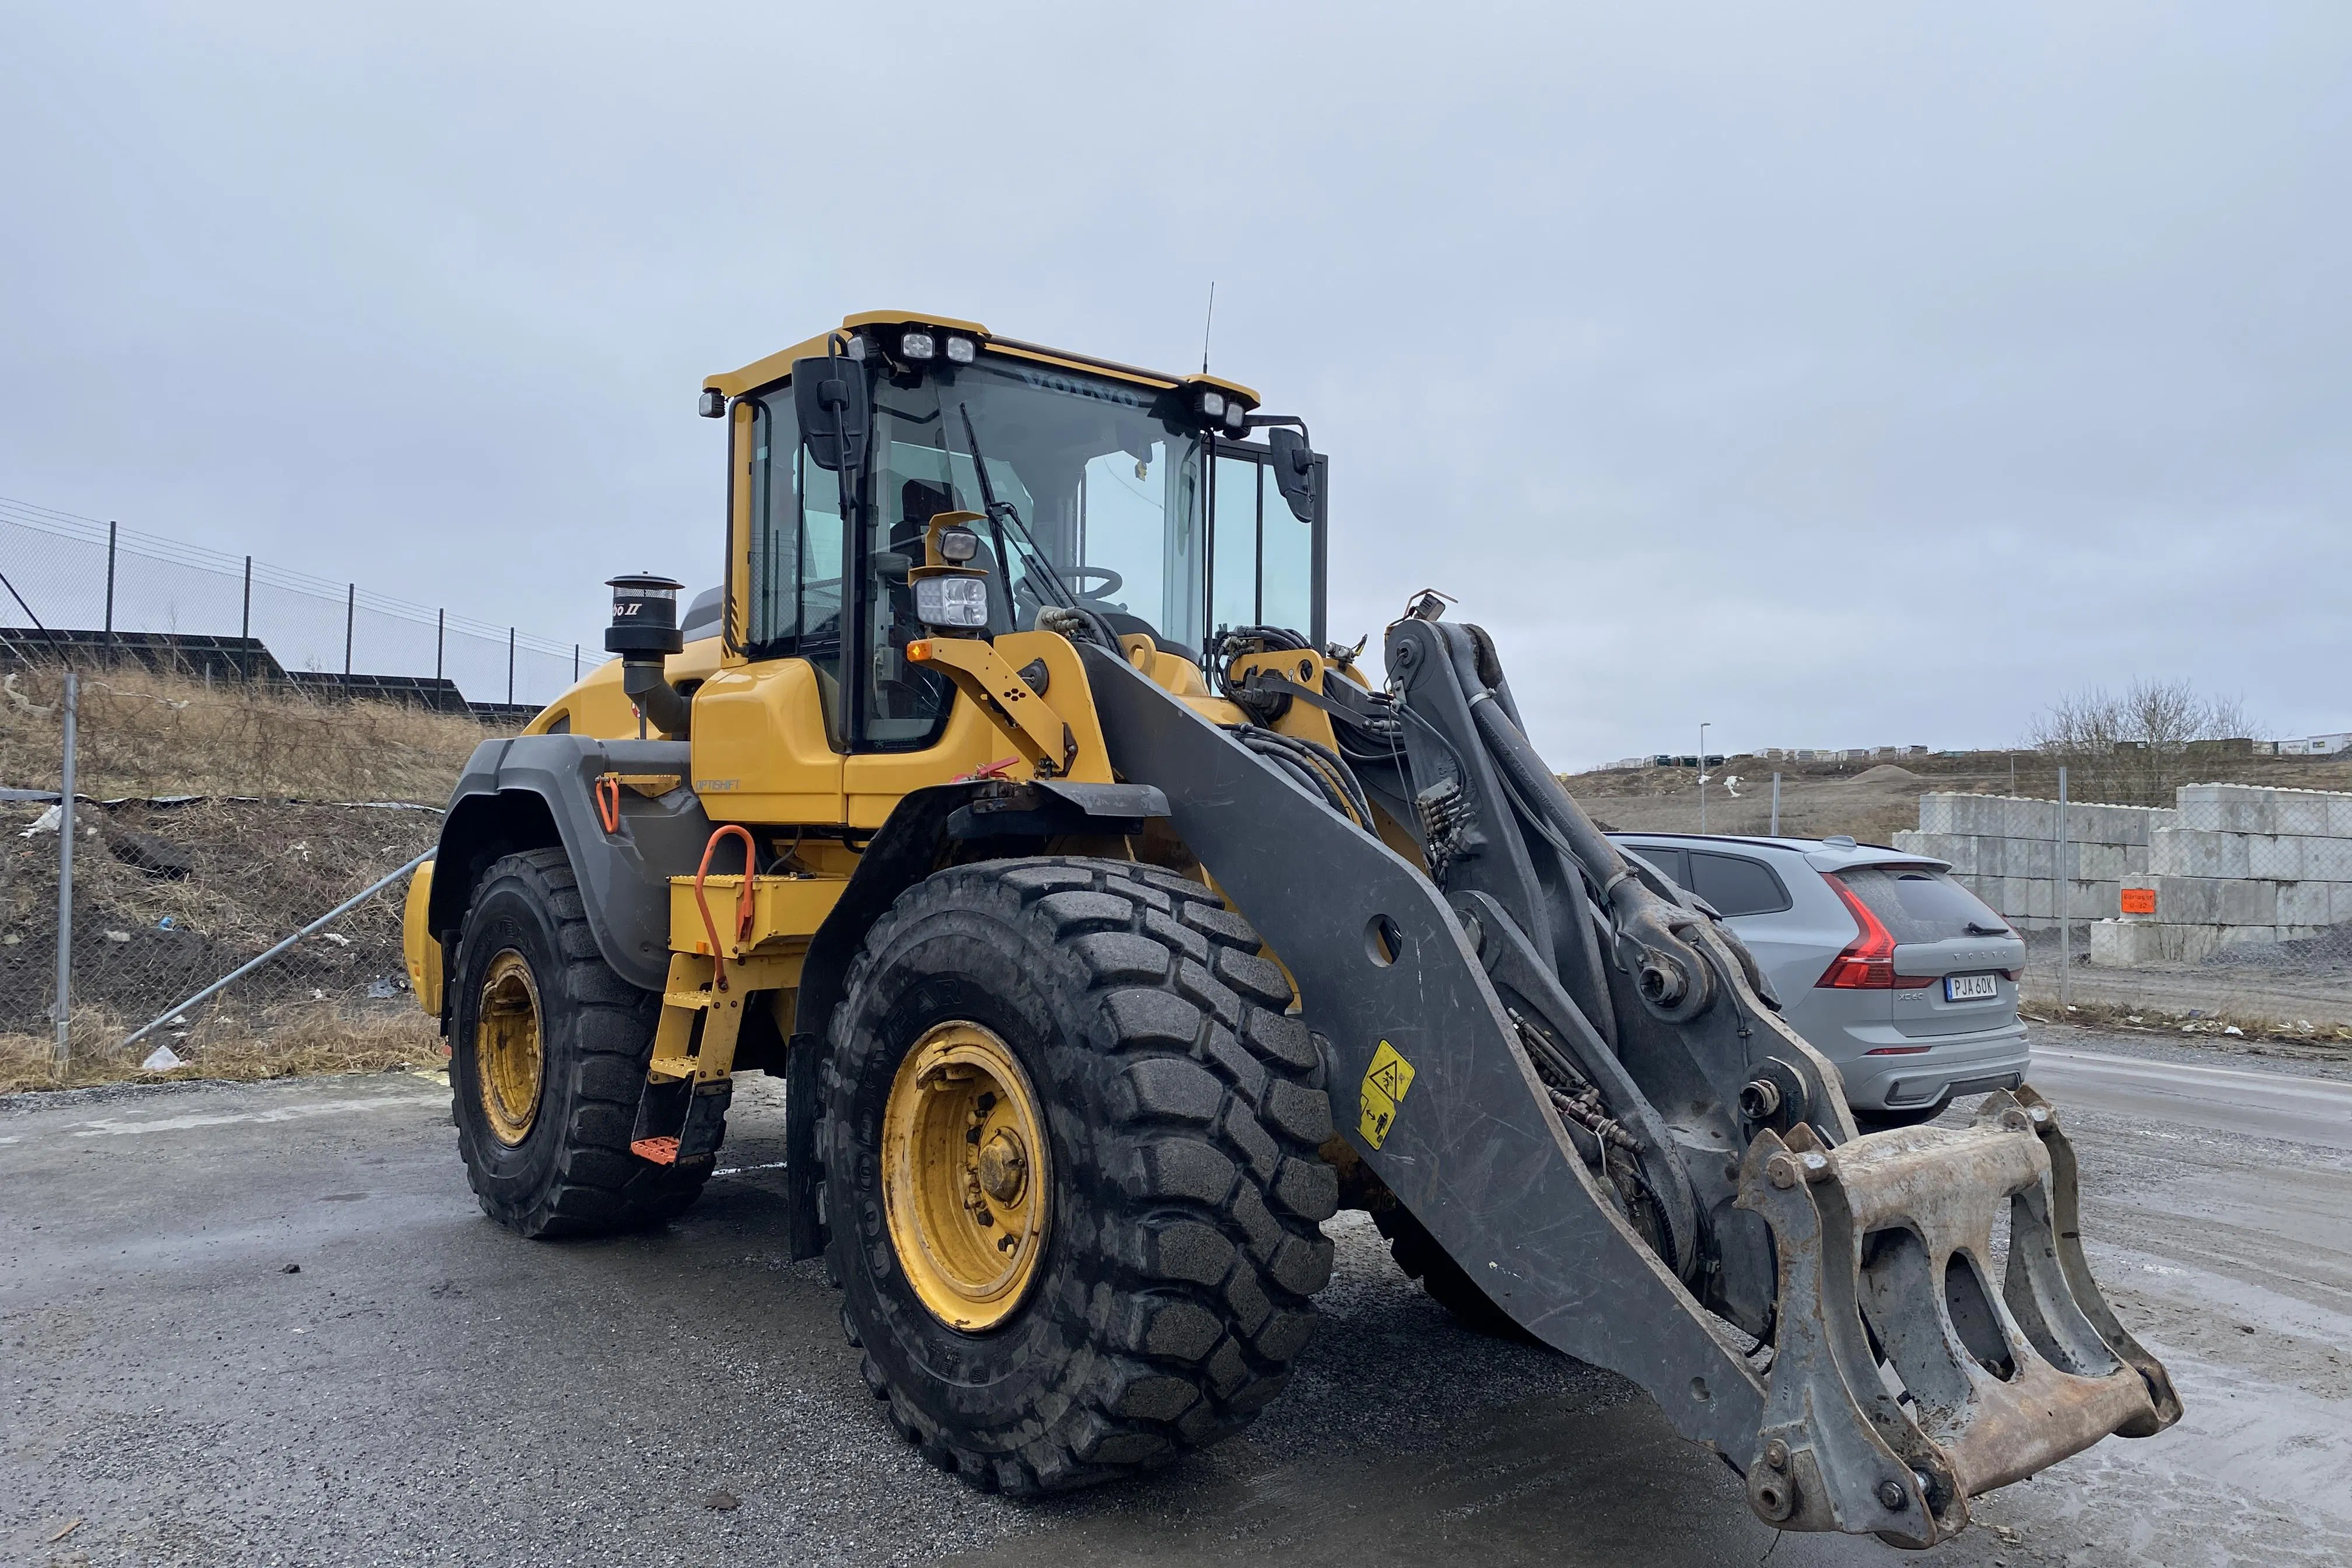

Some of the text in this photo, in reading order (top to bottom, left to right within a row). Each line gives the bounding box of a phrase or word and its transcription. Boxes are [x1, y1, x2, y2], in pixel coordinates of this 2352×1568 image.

[1016, 368, 1139, 409] VOLVO
[624, 603, 642, 615] II
[695, 779, 741, 790] OPTISHIFT
[1954, 950, 2007, 961] VOLVO
[1954, 977, 1993, 996] PJA 60K
